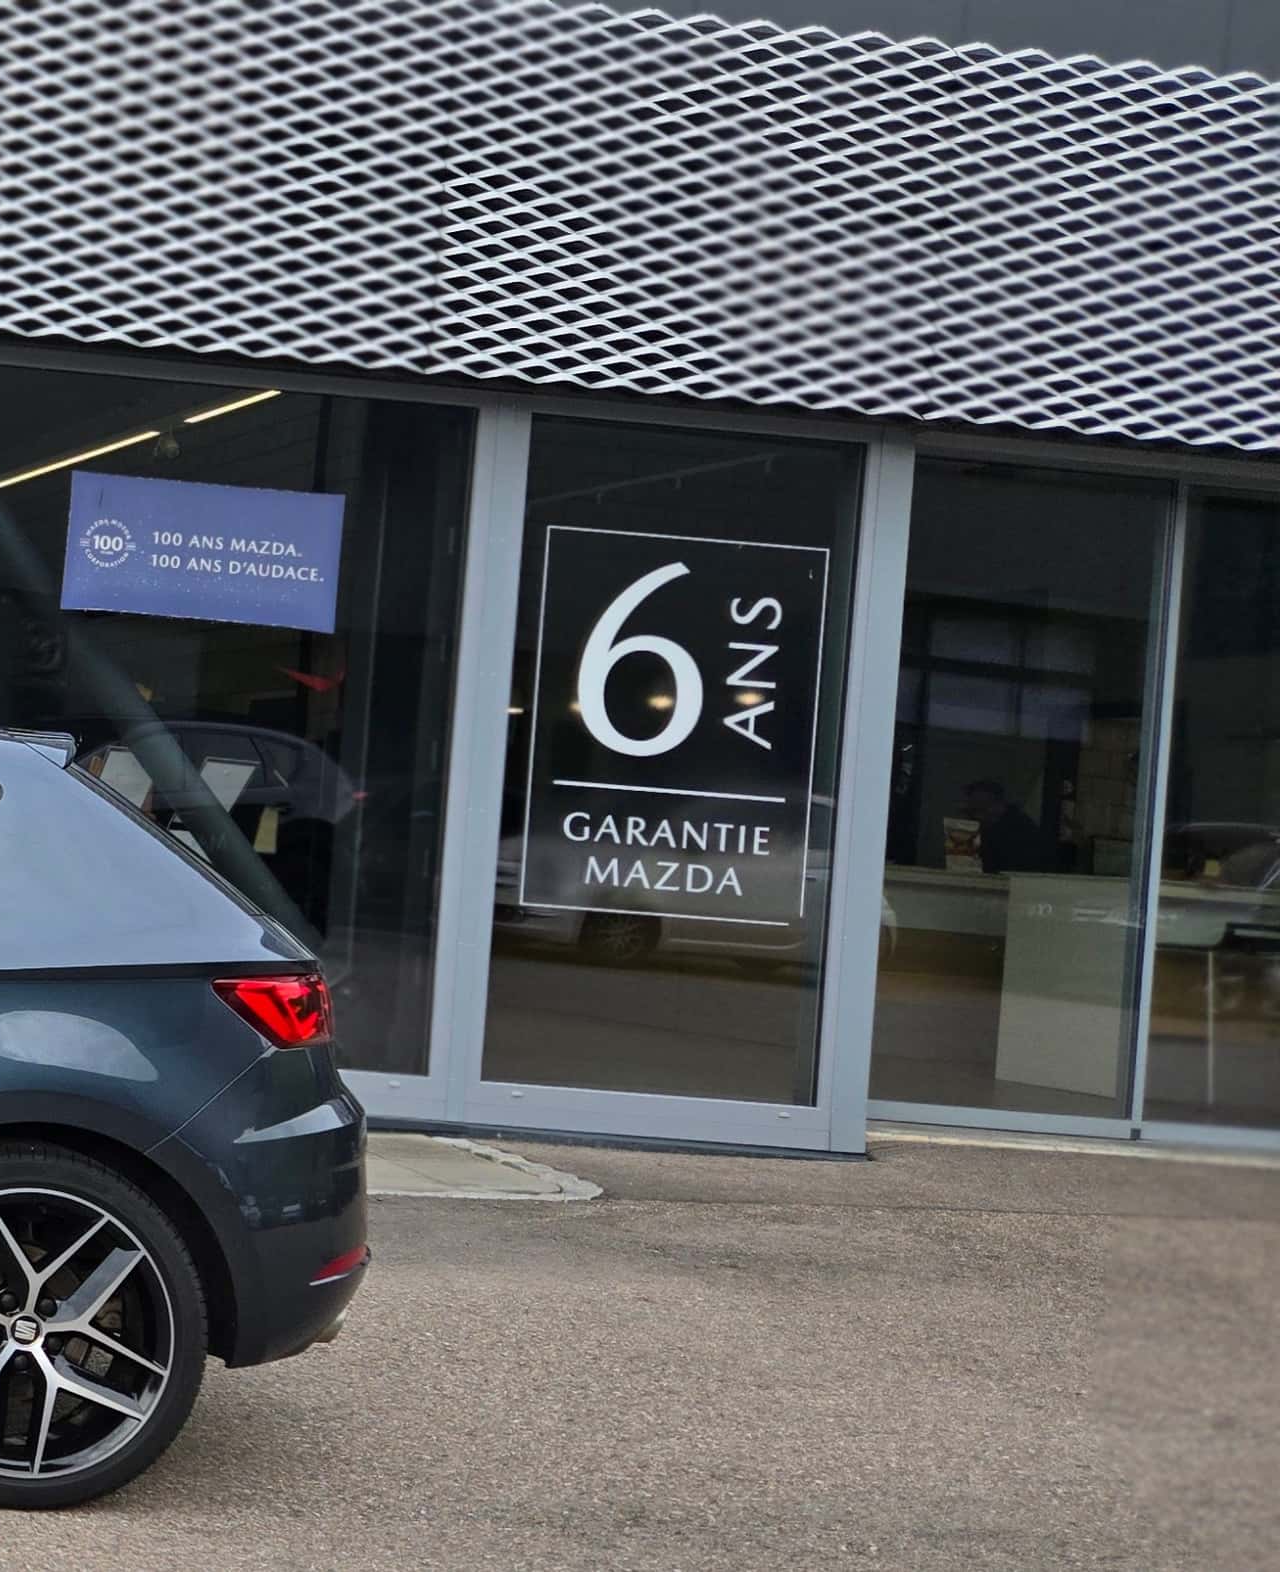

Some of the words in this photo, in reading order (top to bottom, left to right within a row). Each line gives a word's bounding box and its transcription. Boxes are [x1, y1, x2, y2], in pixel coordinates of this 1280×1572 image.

[92, 534, 124, 552] 100
[152, 531, 183, 546] 100
[189, 535, 224, 550] ANS
[230, 538, 303, 558] MAZDA.
[151, 554, 181, 569] 100
[187, 557, 222, 573] ANS
[577, 561, 704, 757] 6
[723, 597, 783, 750] ANS
[562, 811, 771, 856] GARANTIE
[584, 856, 743, 896] MAZDA
